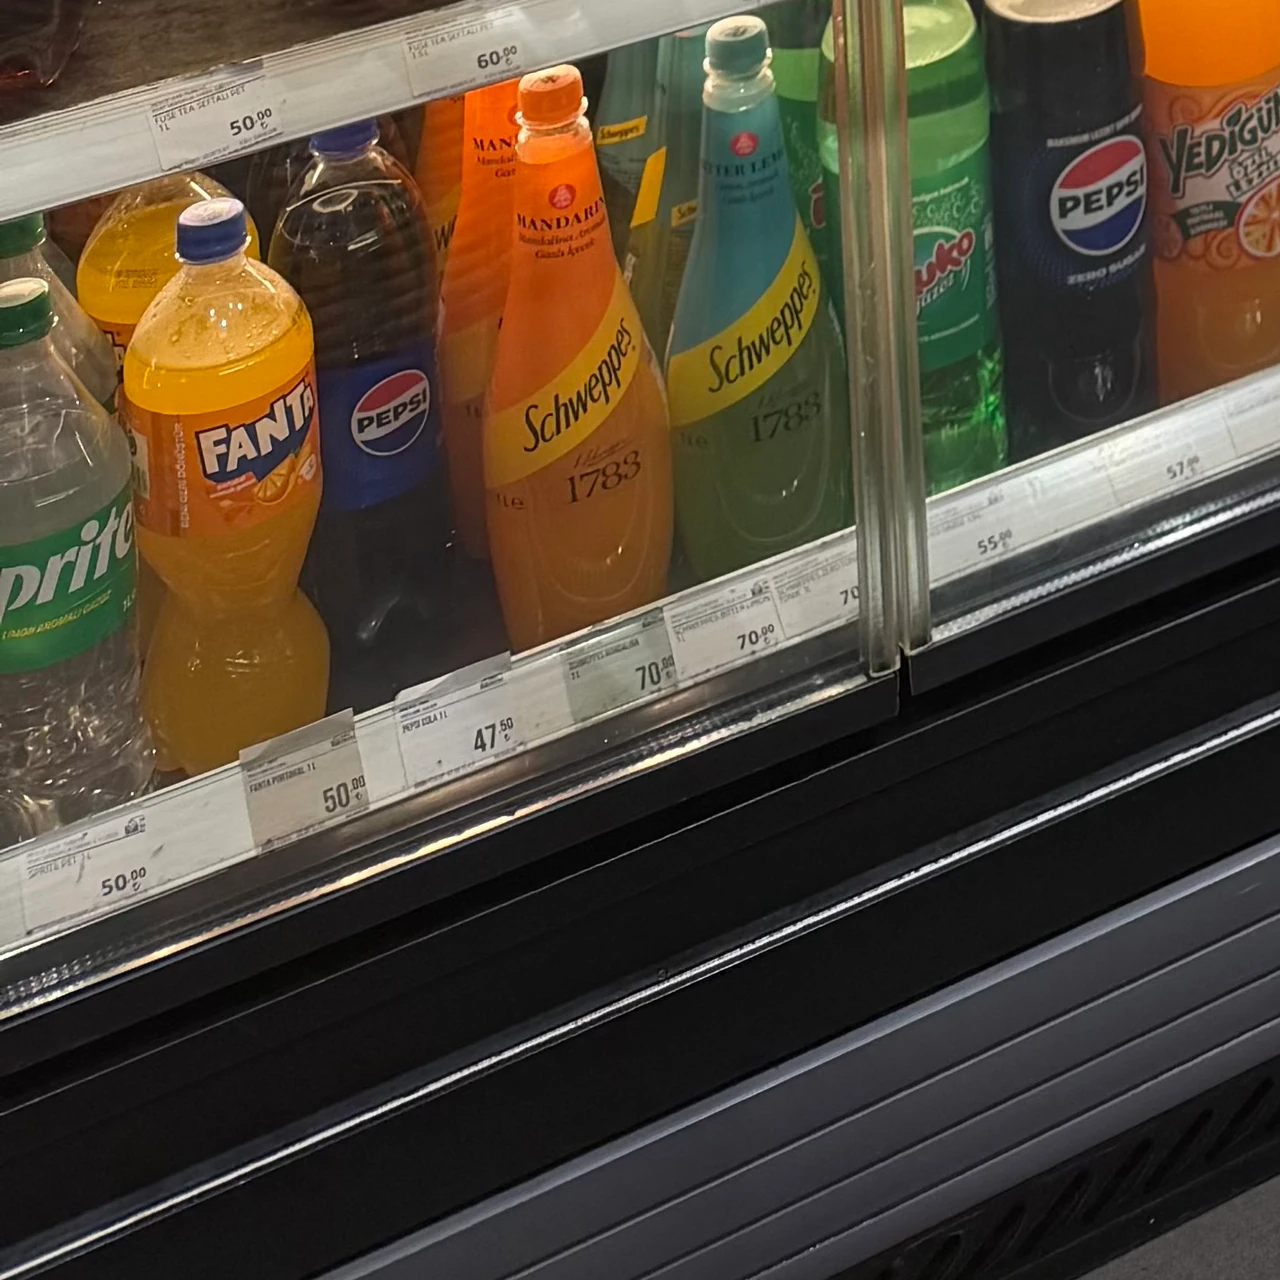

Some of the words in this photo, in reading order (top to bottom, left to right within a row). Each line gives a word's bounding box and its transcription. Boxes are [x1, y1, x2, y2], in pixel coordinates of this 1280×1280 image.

[1058, 170, 1146, 220] PEPSI
[1067, 266, 1104, 284] ZERO
[708, 259, 817, 394] Schweppes
[523, 317, 635, 453] Schweppes
[199, 382, 314, 475] FANTA
[357, 393, 427, 435] PEPSI
[751, 391, 821, 443] 1783
[568, 451, 641, 505] 1783
[0, 500, 133, 616] prite
